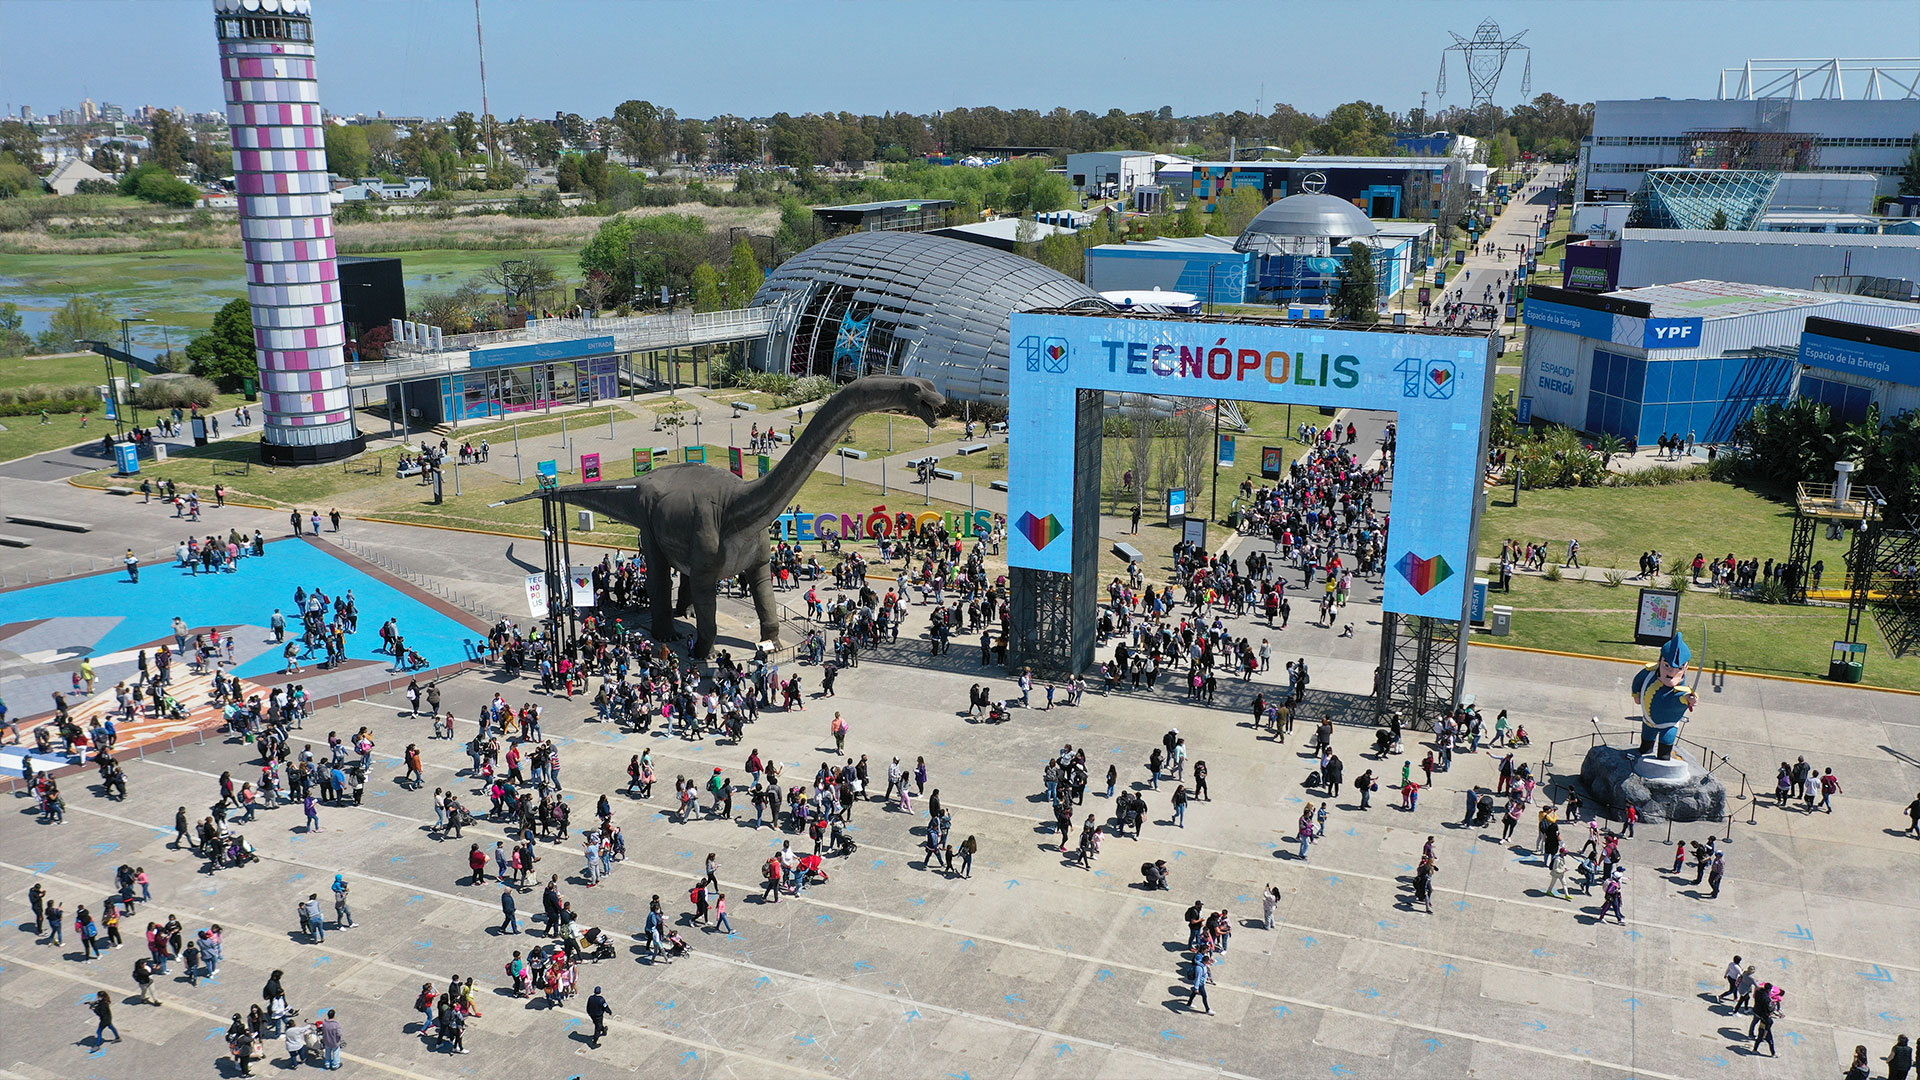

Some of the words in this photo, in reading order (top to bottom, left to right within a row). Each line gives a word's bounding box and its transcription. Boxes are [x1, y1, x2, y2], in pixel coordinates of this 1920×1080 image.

[1527, 310, 1546, 321] Espacio
[1546, 313, 1554, 323] de
[1554, 314, 1560, 324] la
[1560, 316, 1581, 329] Energía
[1655, 326, 1693, 339] YPF
[587, 341, 613, 350] ENTRADA
[1101, 337, 1361, 389] TECNÓPOLIS
[1805, 347, 1835, 361] Espacio
[1836, 353, 1847, 364] de
[1848, 355, 1856, 365] la
[1857, 357, 1890, 373] Energía
[1540, 361, 1571, 378] ESPACIO
[528, 575, 543, 584] TEC
[529, 583, 541, 592] NÓ
